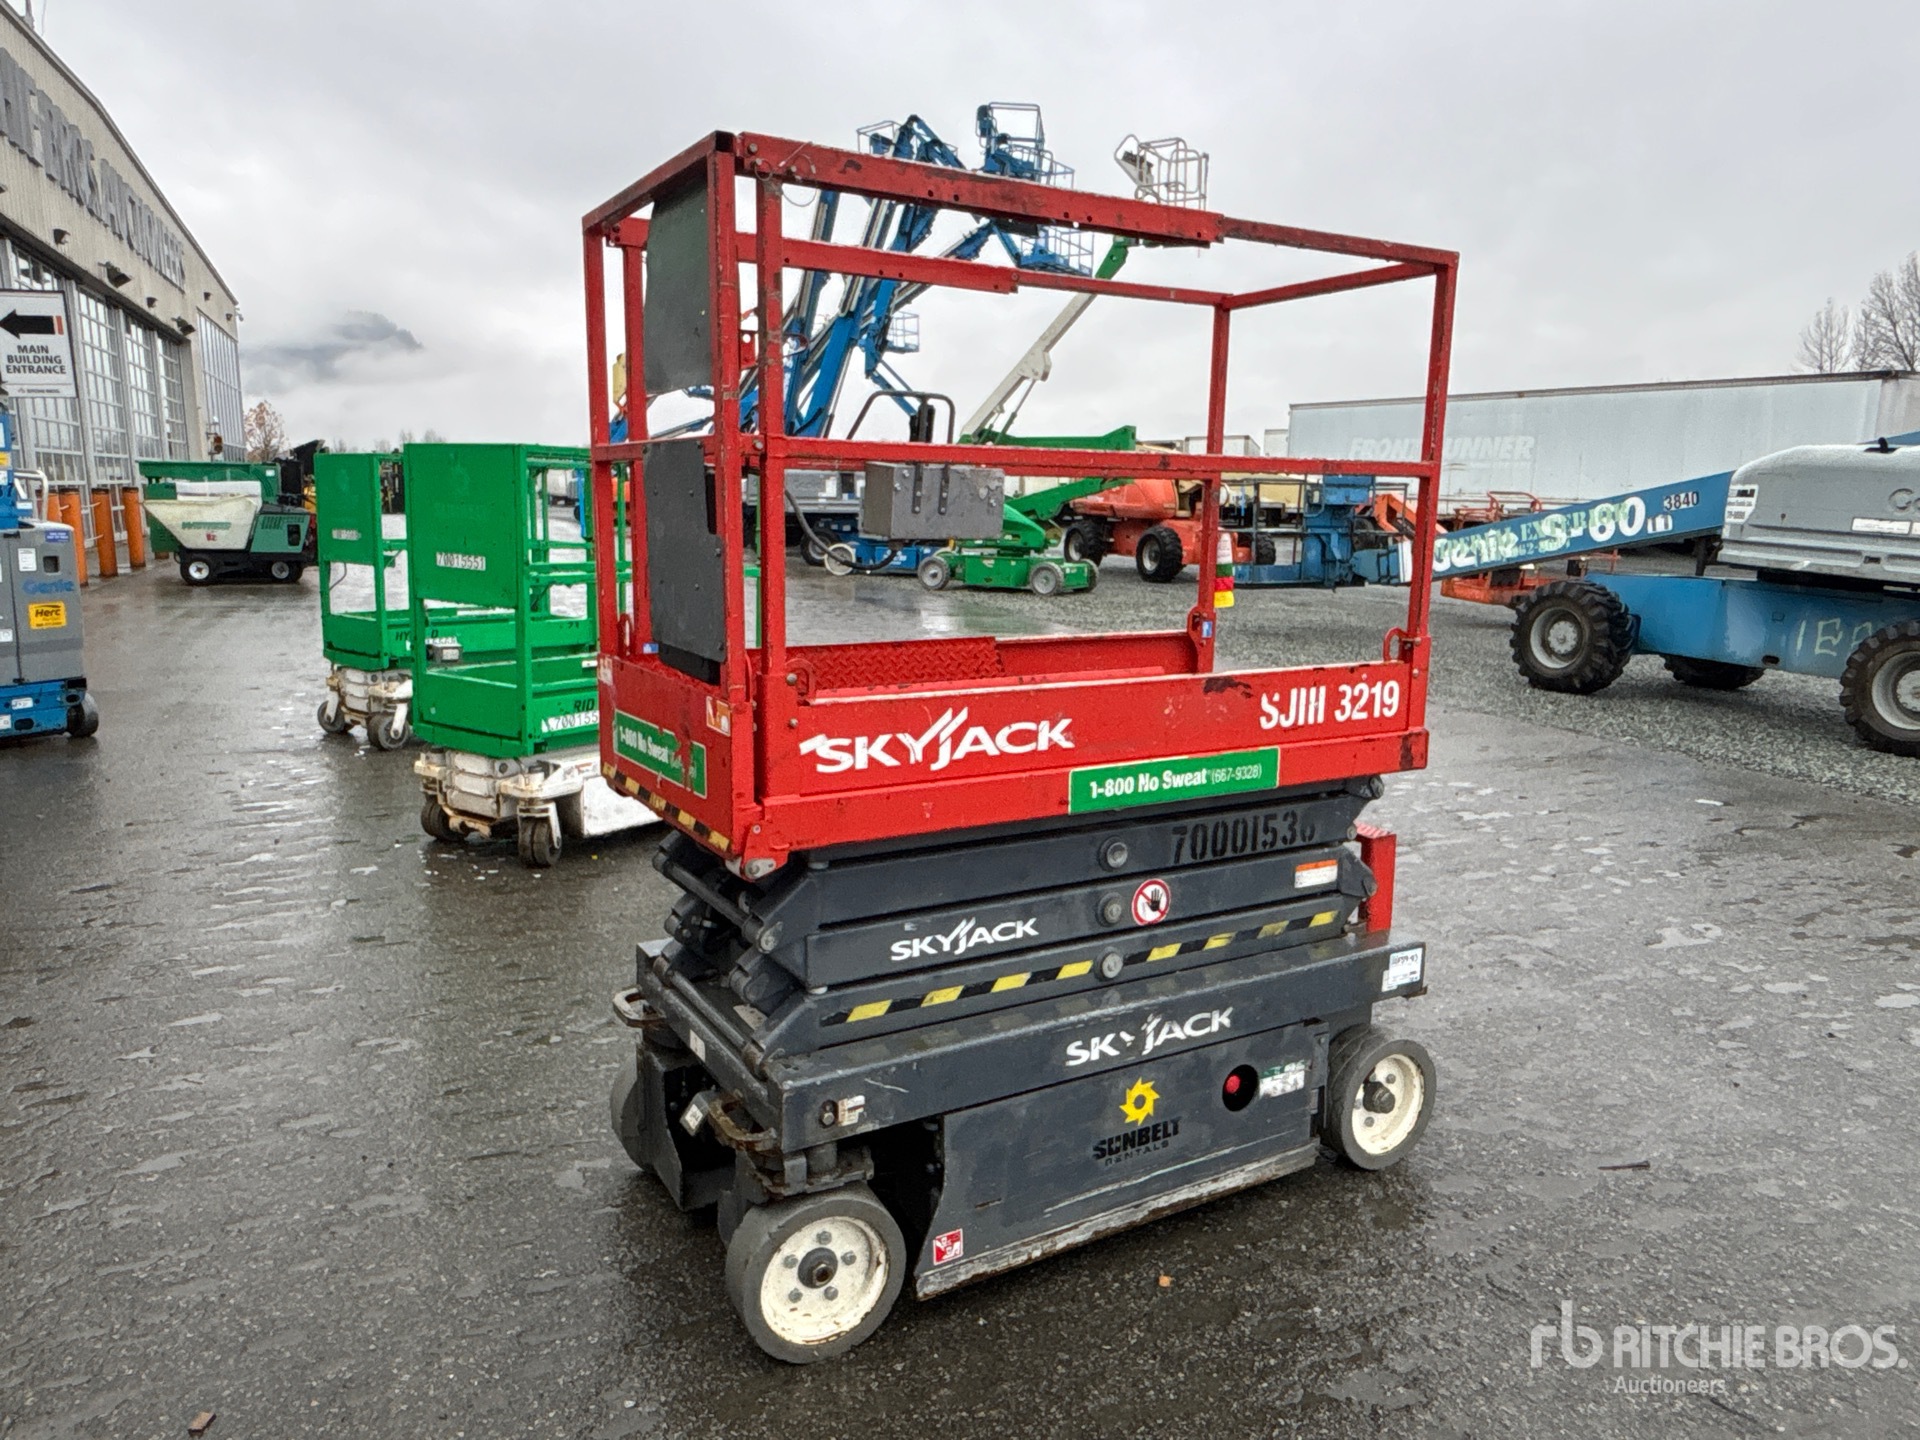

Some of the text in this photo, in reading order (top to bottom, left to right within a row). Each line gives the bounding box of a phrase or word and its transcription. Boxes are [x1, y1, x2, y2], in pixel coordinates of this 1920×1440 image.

[7, 354, 62, 364] BUILDING
[17, 344, 49, 354] MAIN
[6, 364, 67, 375] ENTRANCE
[1664, 491, 1699, 510] 3840
[23, 578, 74, 595] Genie
[35, 608, 61, 617] Herc
[1334, 680, 1400, 722] 3219
[815, 706, 1076, 773] SKYJACK
[1090, 776, 1134, 798] 1-800
[1138, 773, 1160, 793] No
[890, 916, 1040, 961] SKYJACK
[1092, 1116, 1182, 1160] SUNBELT
[1104, 1140, 1170, 1167] RENTALS
